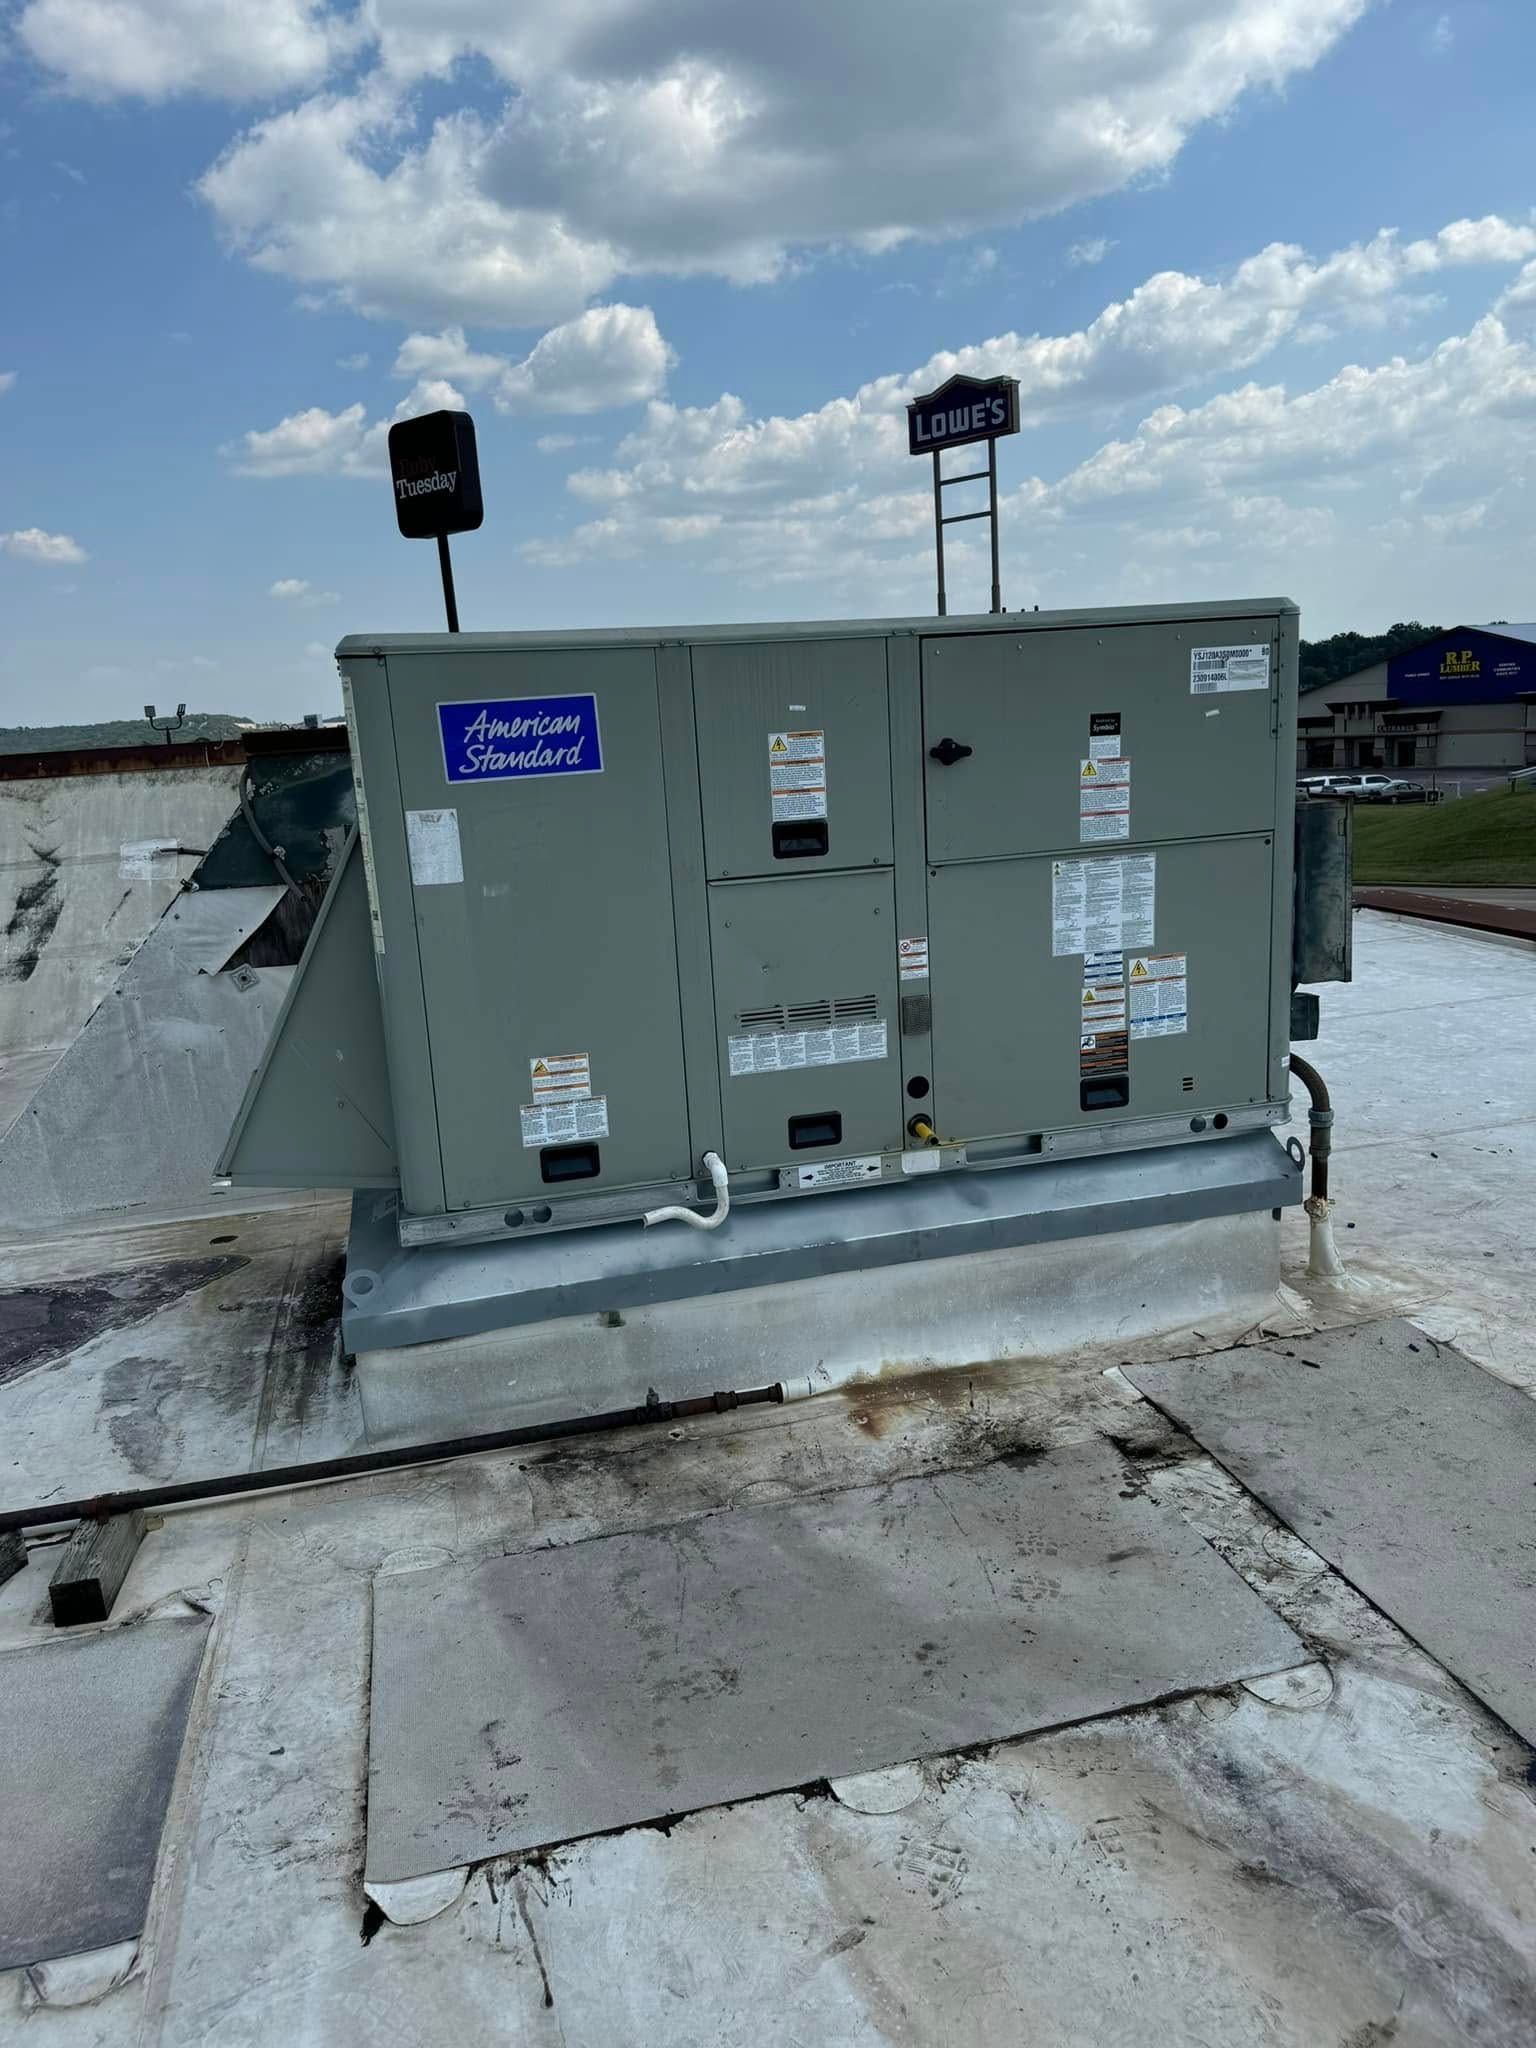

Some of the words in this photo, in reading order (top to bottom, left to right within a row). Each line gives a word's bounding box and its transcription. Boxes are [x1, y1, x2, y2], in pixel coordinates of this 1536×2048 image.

[916, 397, 1005, 442] LOWE'S
[396, 470, 457, 499] Tuesday
[1440, 661, 1480, 673] LUMBER
[464, 709, 581, 744] American
[459, 736, 585, 774] Standard
[824, 1160, 856, 1169] IMPORTANT
